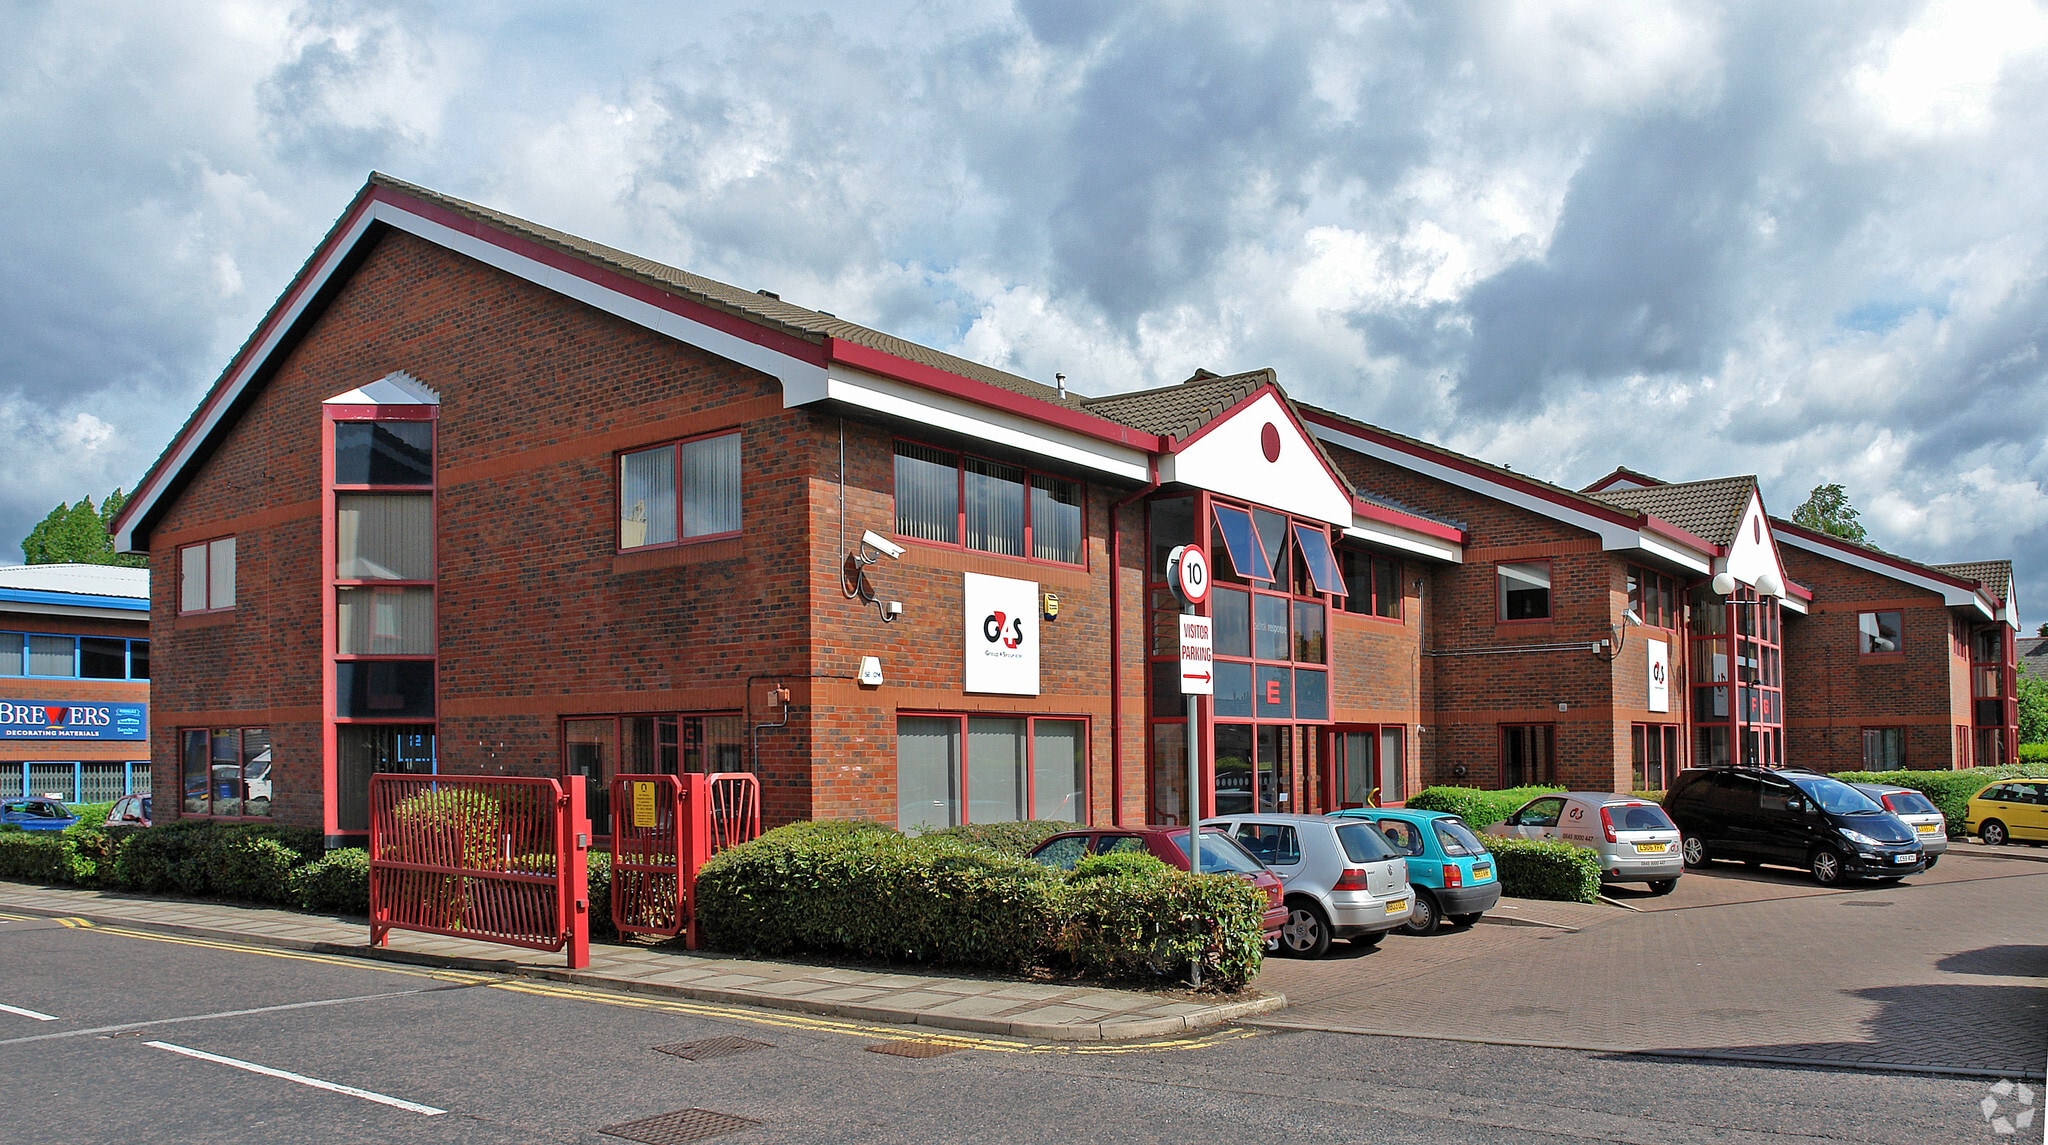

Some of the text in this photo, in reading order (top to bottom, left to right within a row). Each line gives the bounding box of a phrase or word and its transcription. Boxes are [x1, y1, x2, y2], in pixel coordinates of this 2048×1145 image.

[1187, 562, 1202, 585] 10
[983, 610, 1023, 649] G4S
[1183, 623, 1209, 640] VISITOR
[1181, 645, 1212, 662] PARKING
[1265, 680, 1280, 704] E
[1751, 697, 1757, 713] F
[1763, 699, 1770, 714] G
[0, 702, 111, 726] BREWERS
[6, 729, 100, 737] DECORATING MATERIALS
[1569, 807, 1584, 820] G4S
[1562, 832, 1573, 840] 0845
